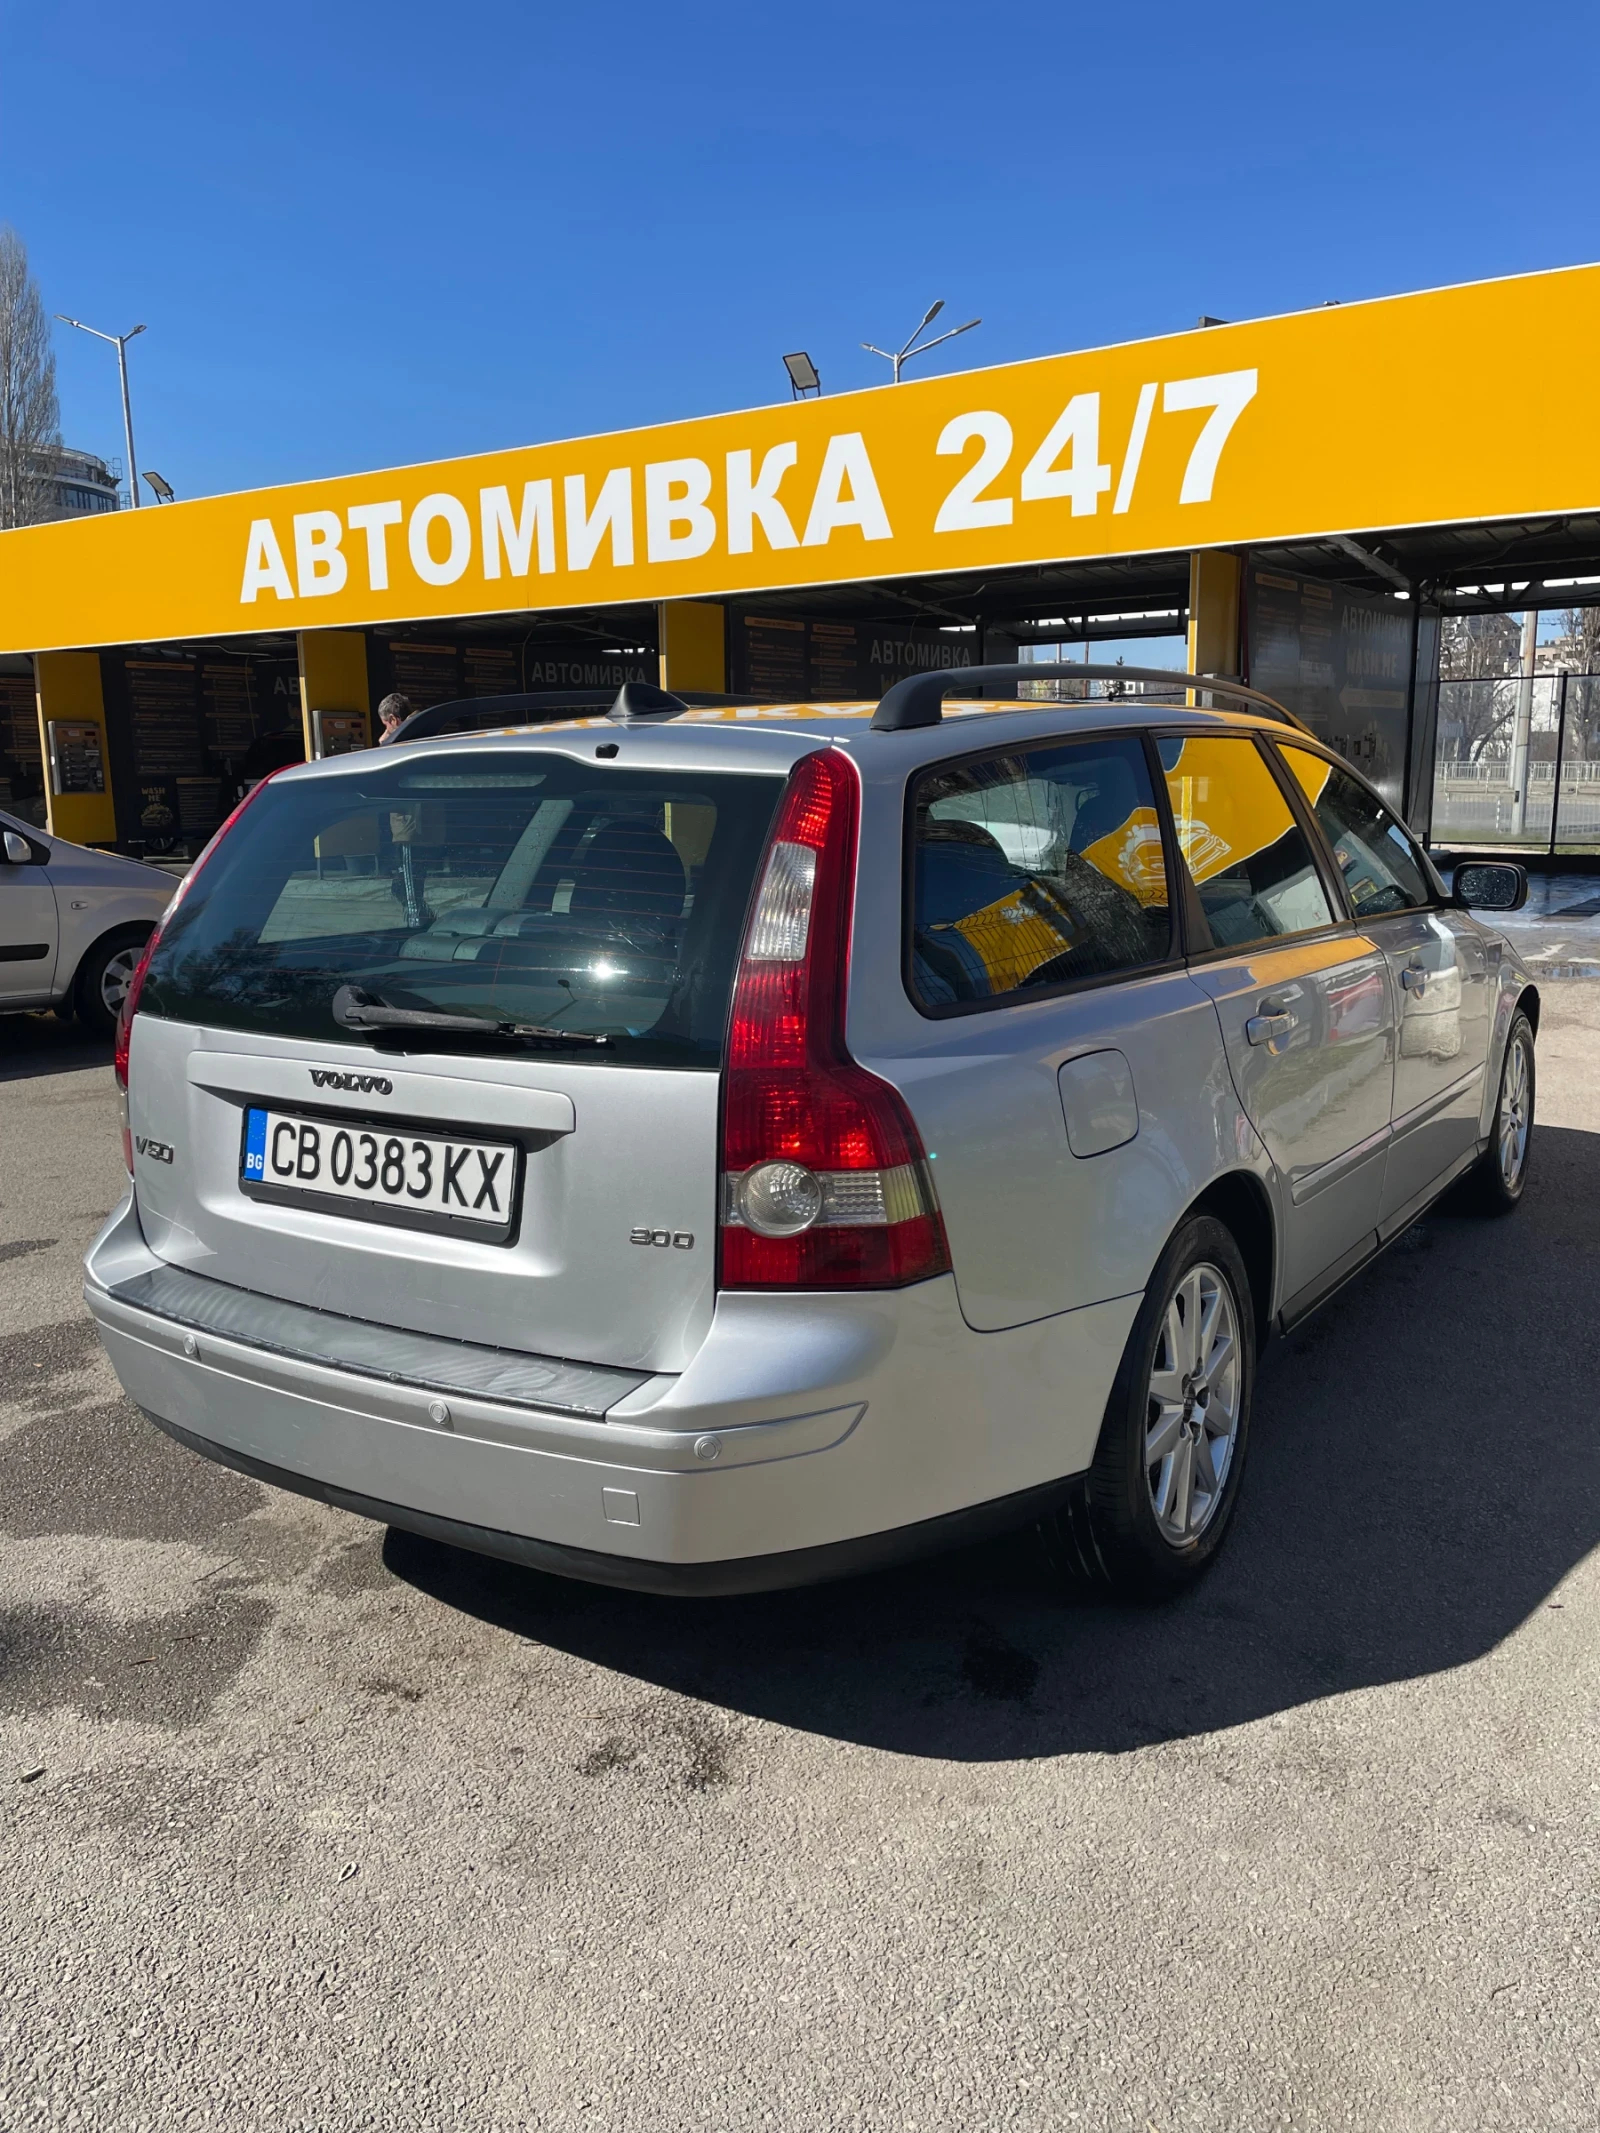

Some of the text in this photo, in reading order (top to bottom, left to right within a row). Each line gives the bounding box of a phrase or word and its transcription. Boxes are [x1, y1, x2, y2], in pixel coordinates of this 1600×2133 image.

[240, 368, 1258, 605] АВТОМИВКА 24/7
[870, 639, 971, 668] АВТОМИВКА
[531, 661, 647, 686] АВТОМИВКА
[141, 787, 166, 795] WASH
[308, 1068, 393, 1096] VOLVO
[135, 1135, 175, 1165] V50
[246, 1152, 263, 1171] BG
[271, 1121, 505, 1213] CB 0383 KX
